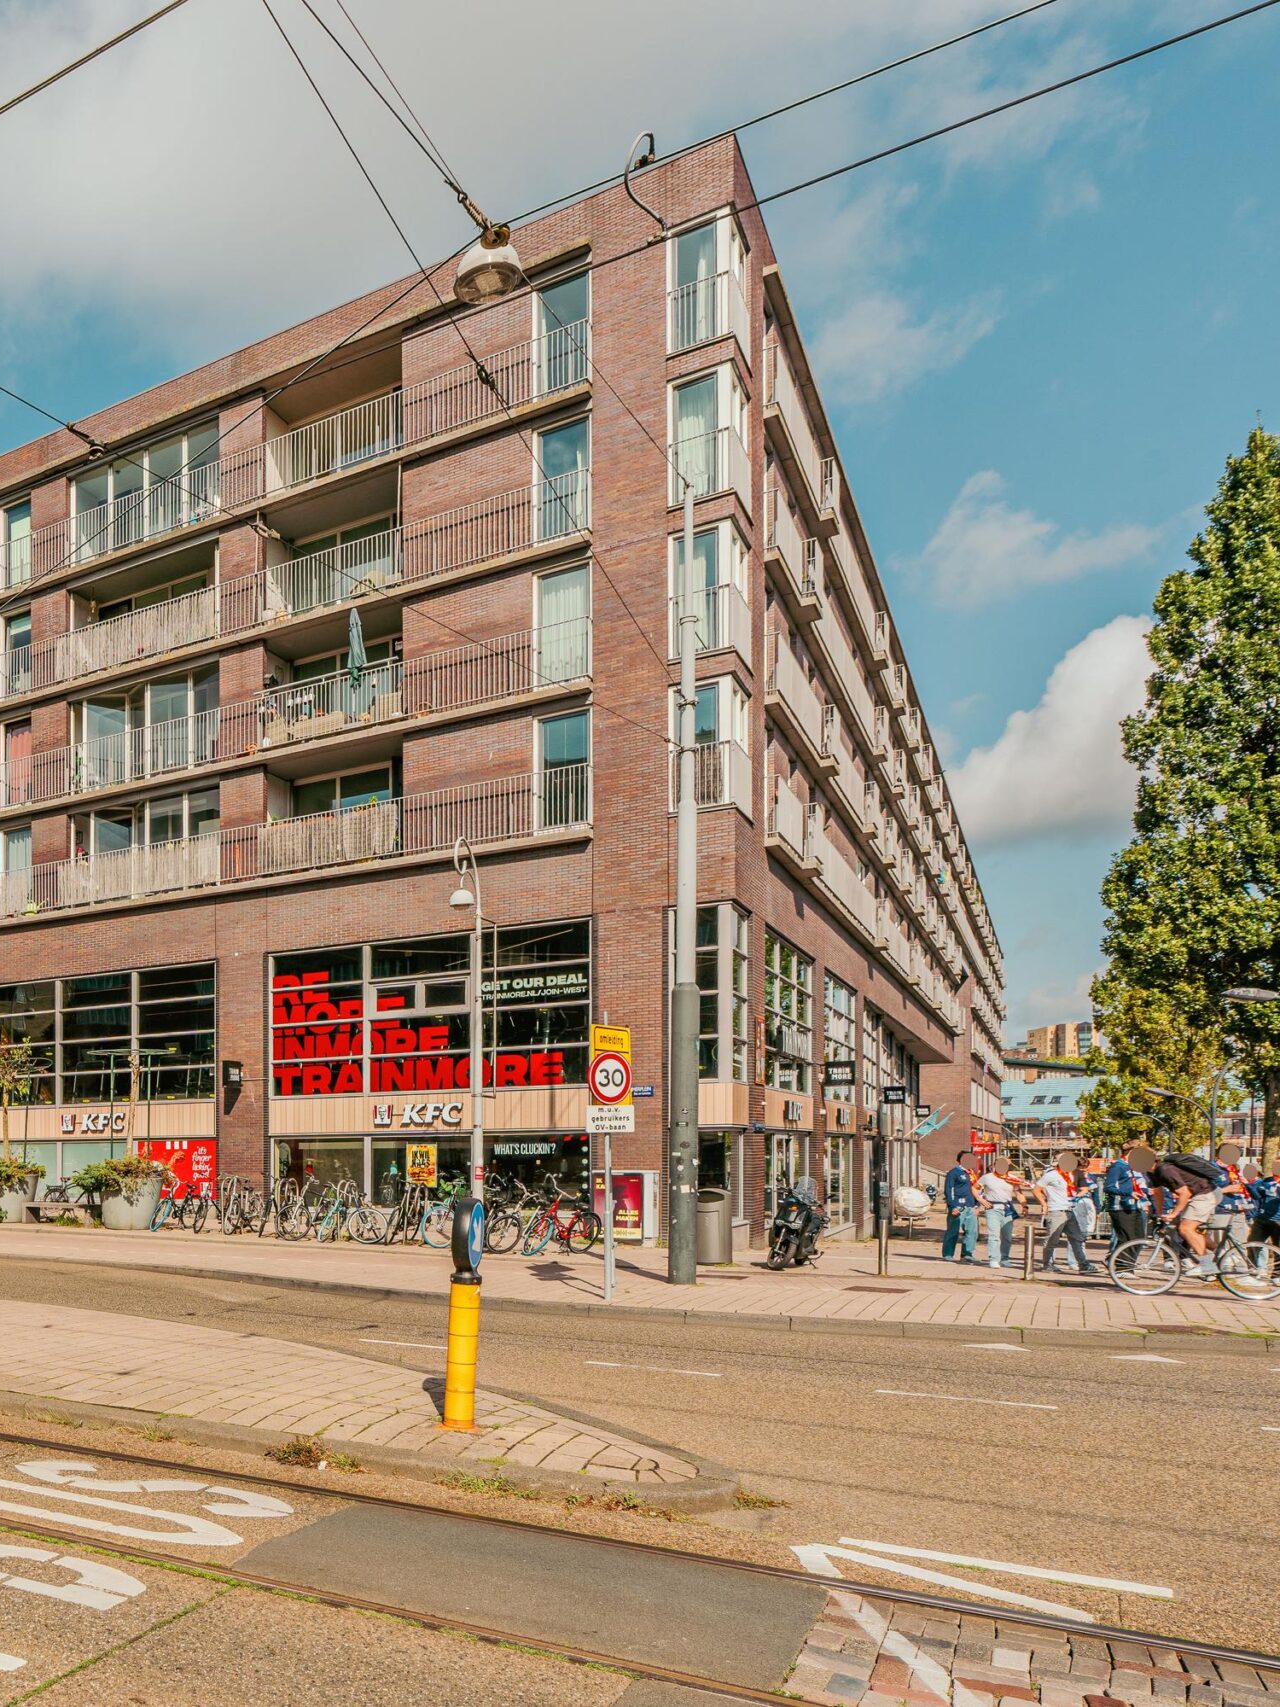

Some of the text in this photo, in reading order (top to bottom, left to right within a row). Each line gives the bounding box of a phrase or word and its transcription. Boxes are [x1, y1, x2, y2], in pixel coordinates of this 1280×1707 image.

[273, 971, 329, 1006] RE
[481, 973, 587, 992] GET OUR DEAL
[273, 996, 405, 1036] MORE
[273, 1052, 563, 1097] TRAINMORE
[598, 1068, 624, 1087] 30
[80, 1112, 125, 1131] KFC
[401, 1102, 463, 1124] KFC
[591, 1115, 630, 1123] gebruikers
[494, 1142, 556, 1155] WHAT'S CLUCKIN'?
